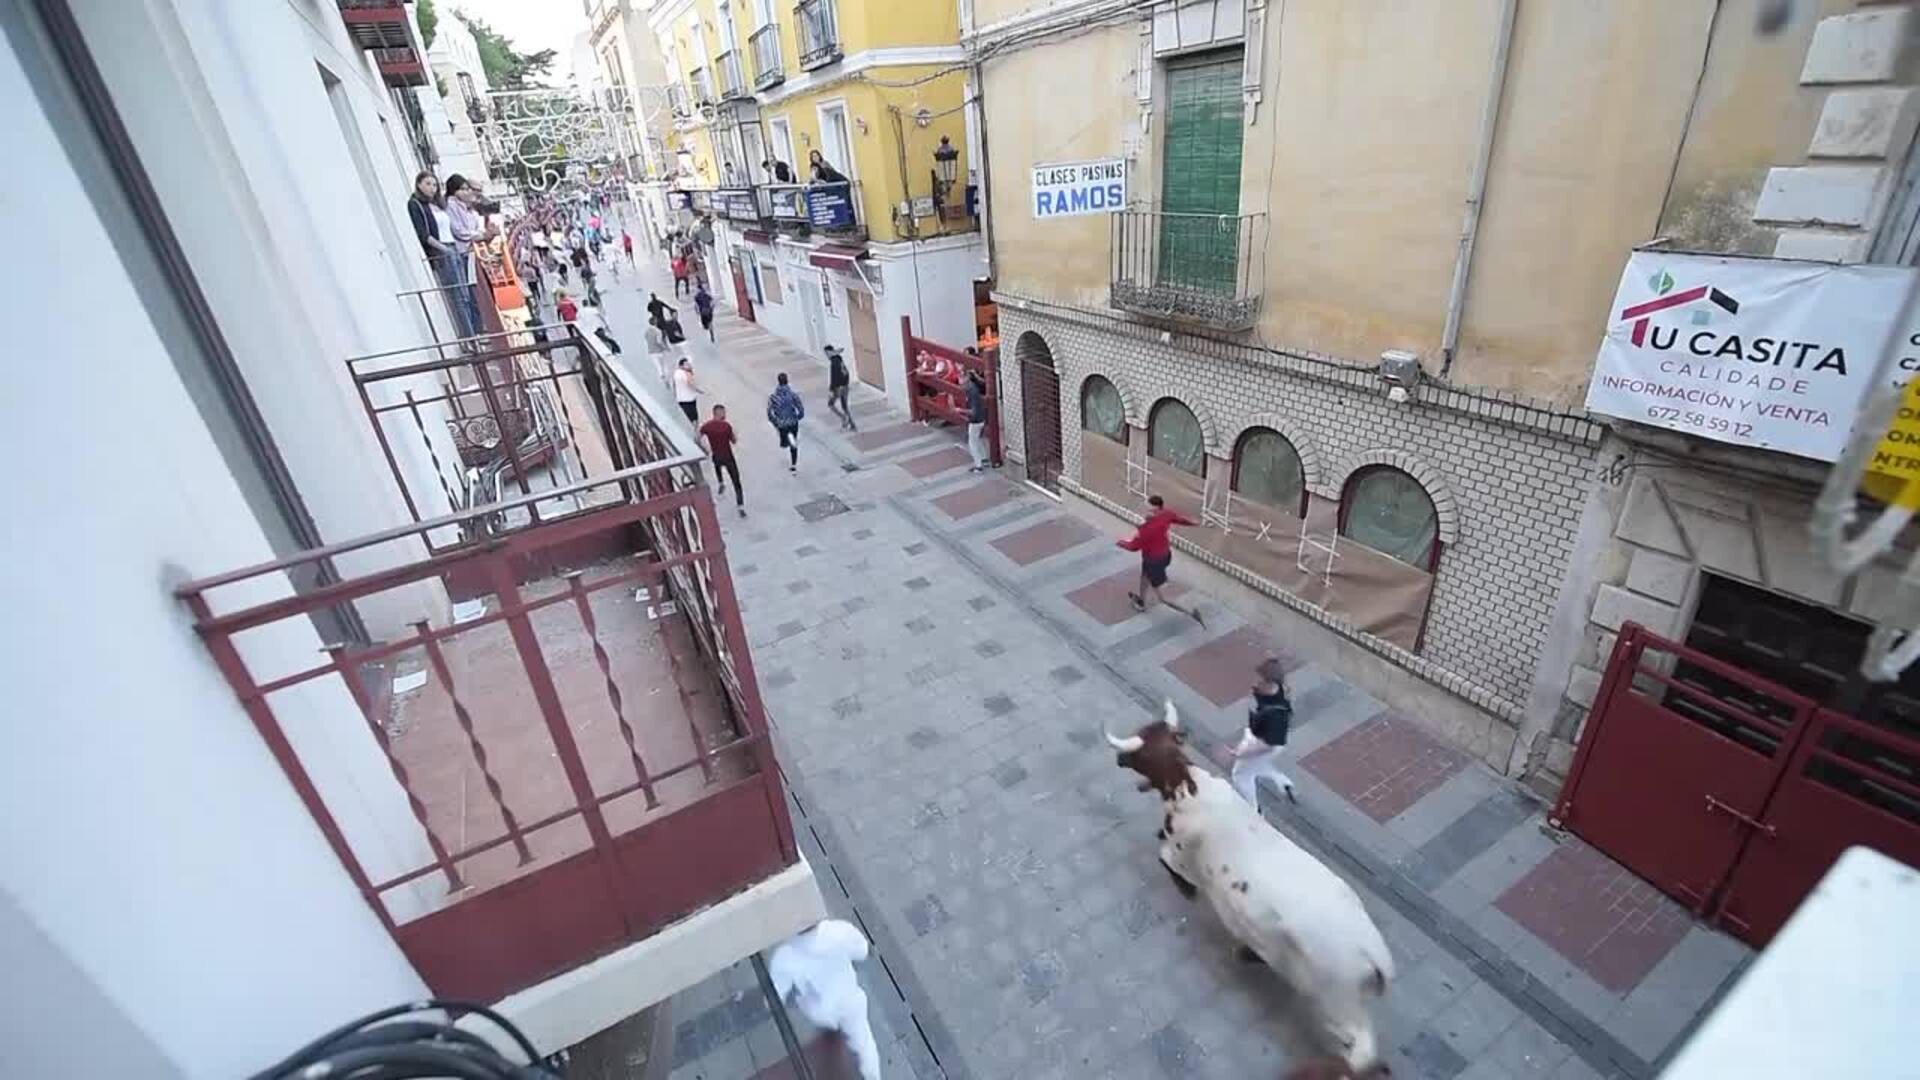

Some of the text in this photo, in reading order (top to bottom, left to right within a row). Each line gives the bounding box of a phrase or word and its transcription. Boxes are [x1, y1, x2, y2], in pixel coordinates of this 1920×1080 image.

[1036, 163, 1123, 186] CLASES PASIVAS
[1037, 183, 1123, 216] RAMOS
[1689, 332, 1848, 376] CASITA
[1660, 360, 1809, 395] CALIDADE
[1602, 375, 1829, 426] INFORMACIÓN Y VENTA
[1648, 405, 1753, 438] 672 58 59 12
